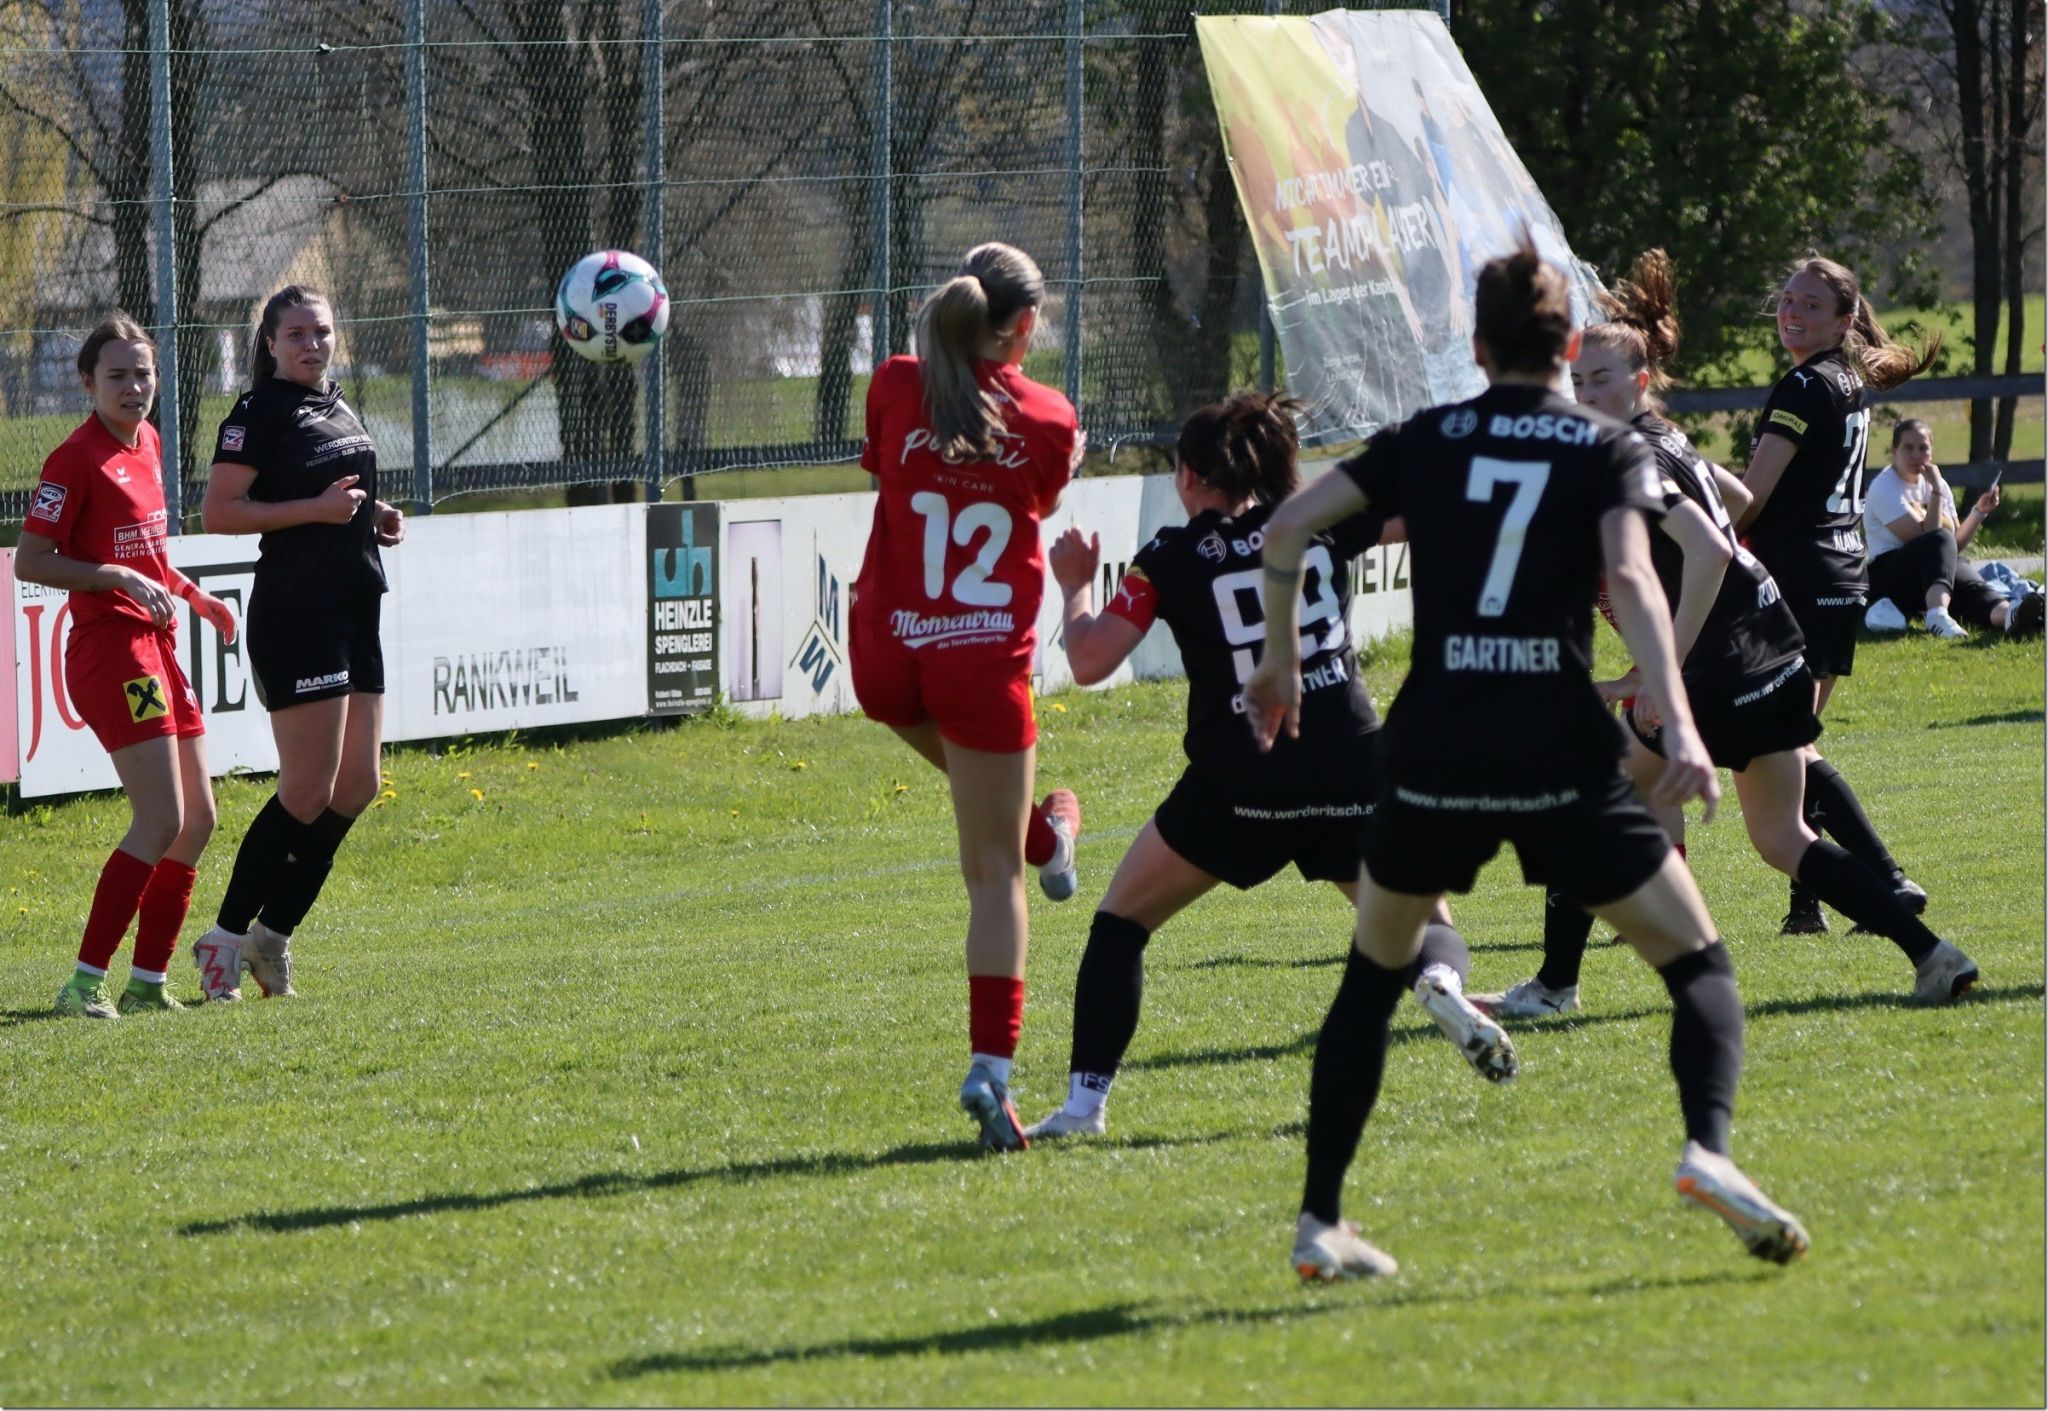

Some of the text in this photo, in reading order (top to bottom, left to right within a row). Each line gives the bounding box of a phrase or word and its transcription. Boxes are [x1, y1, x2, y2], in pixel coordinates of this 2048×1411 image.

[1489, 415, 1598, 446] BOSCH
[118, 529, 138, 541] BHM
[911, 491, 1013, 607] 12
[1466, 455, 1552, 617] 7
[655, 599, 713, 631] HEINZLE
[655, 634, 713, 655] SPENGLEREI
[1445, 635, 1561, 673] GARTNER
[296, 670, 349, 688] MARKO
[433, 646, 579, 716] RANKWEIL
